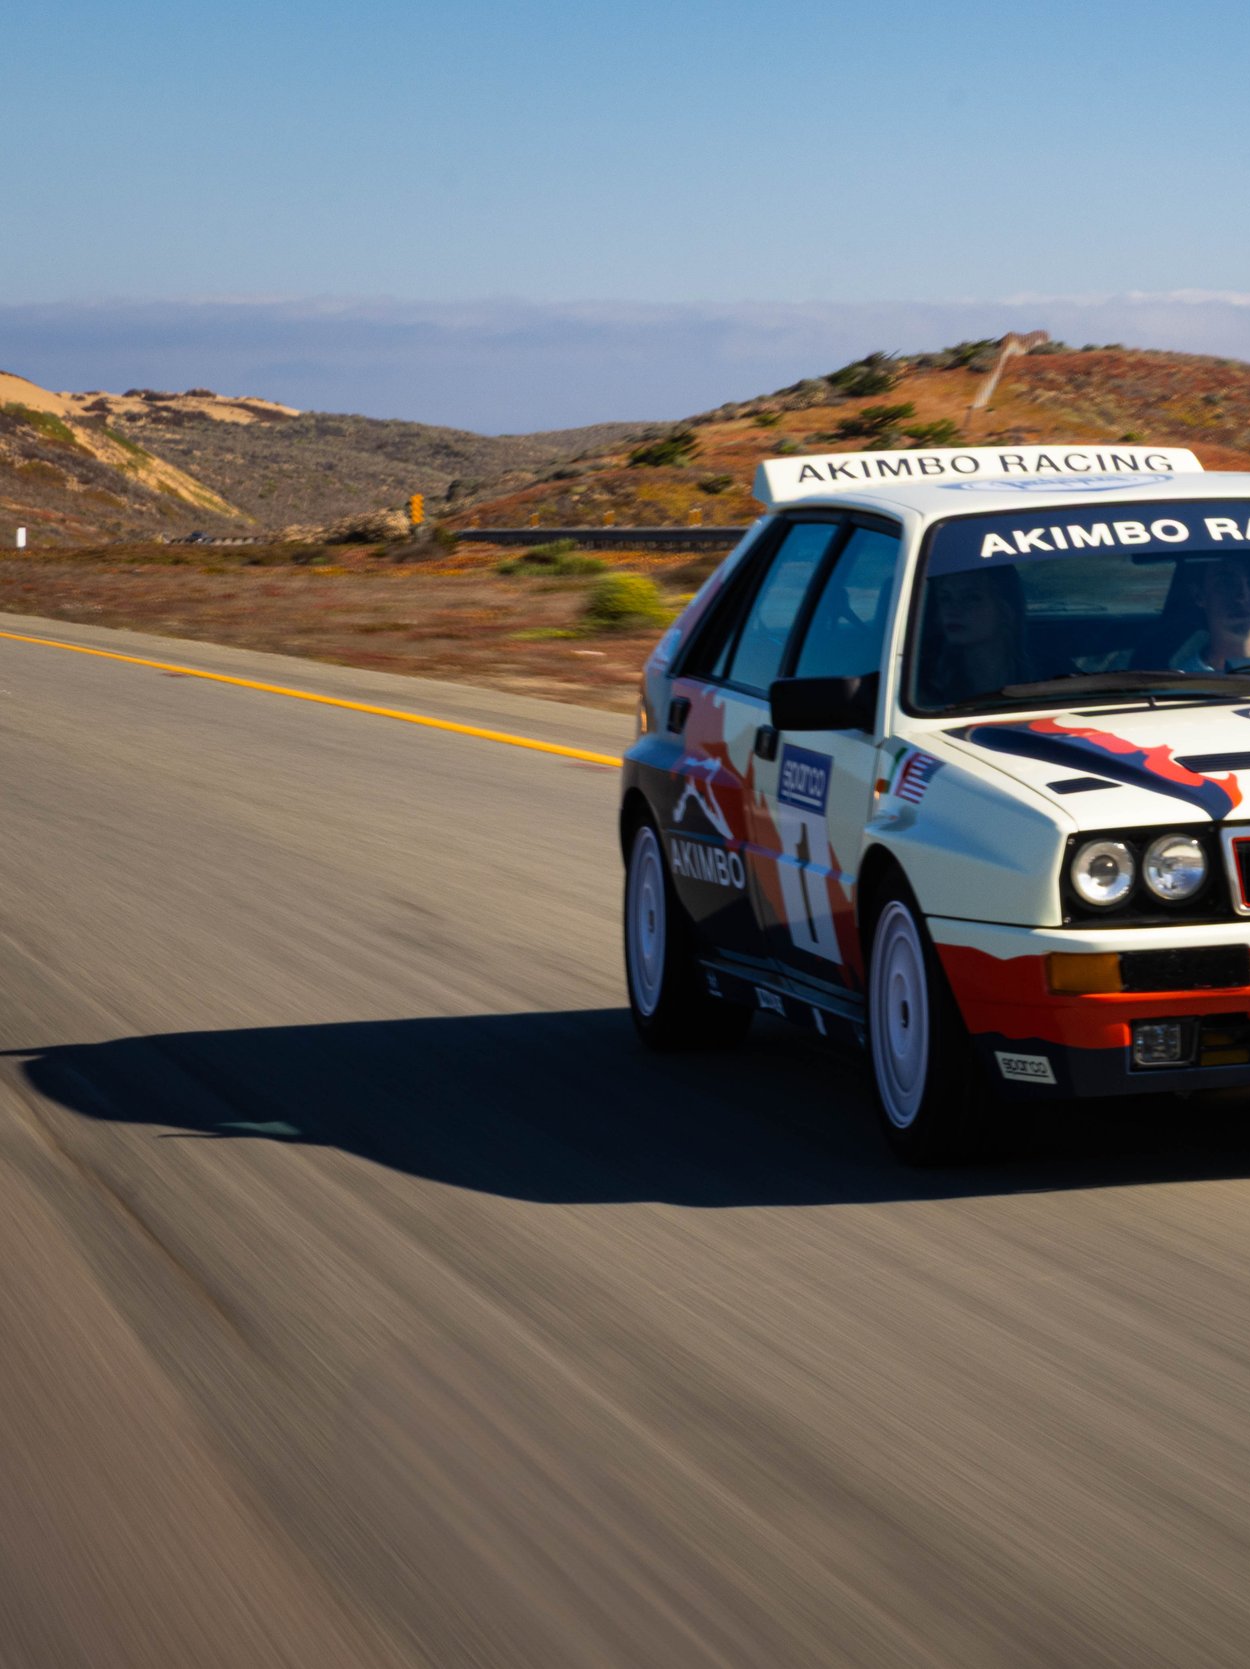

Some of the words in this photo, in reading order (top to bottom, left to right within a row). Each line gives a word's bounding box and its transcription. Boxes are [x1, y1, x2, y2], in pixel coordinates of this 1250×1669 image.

[798, 454, 980, 483] AKIMBO
[999, 452, 1174, 473] RACING
[980, 518, 1190, 558] AKIMBO
[671, 838, 746, 889] AKIMBO
[796, 822, 819, 944] 1
[1002, 1058, 1048, 1074] sparco
